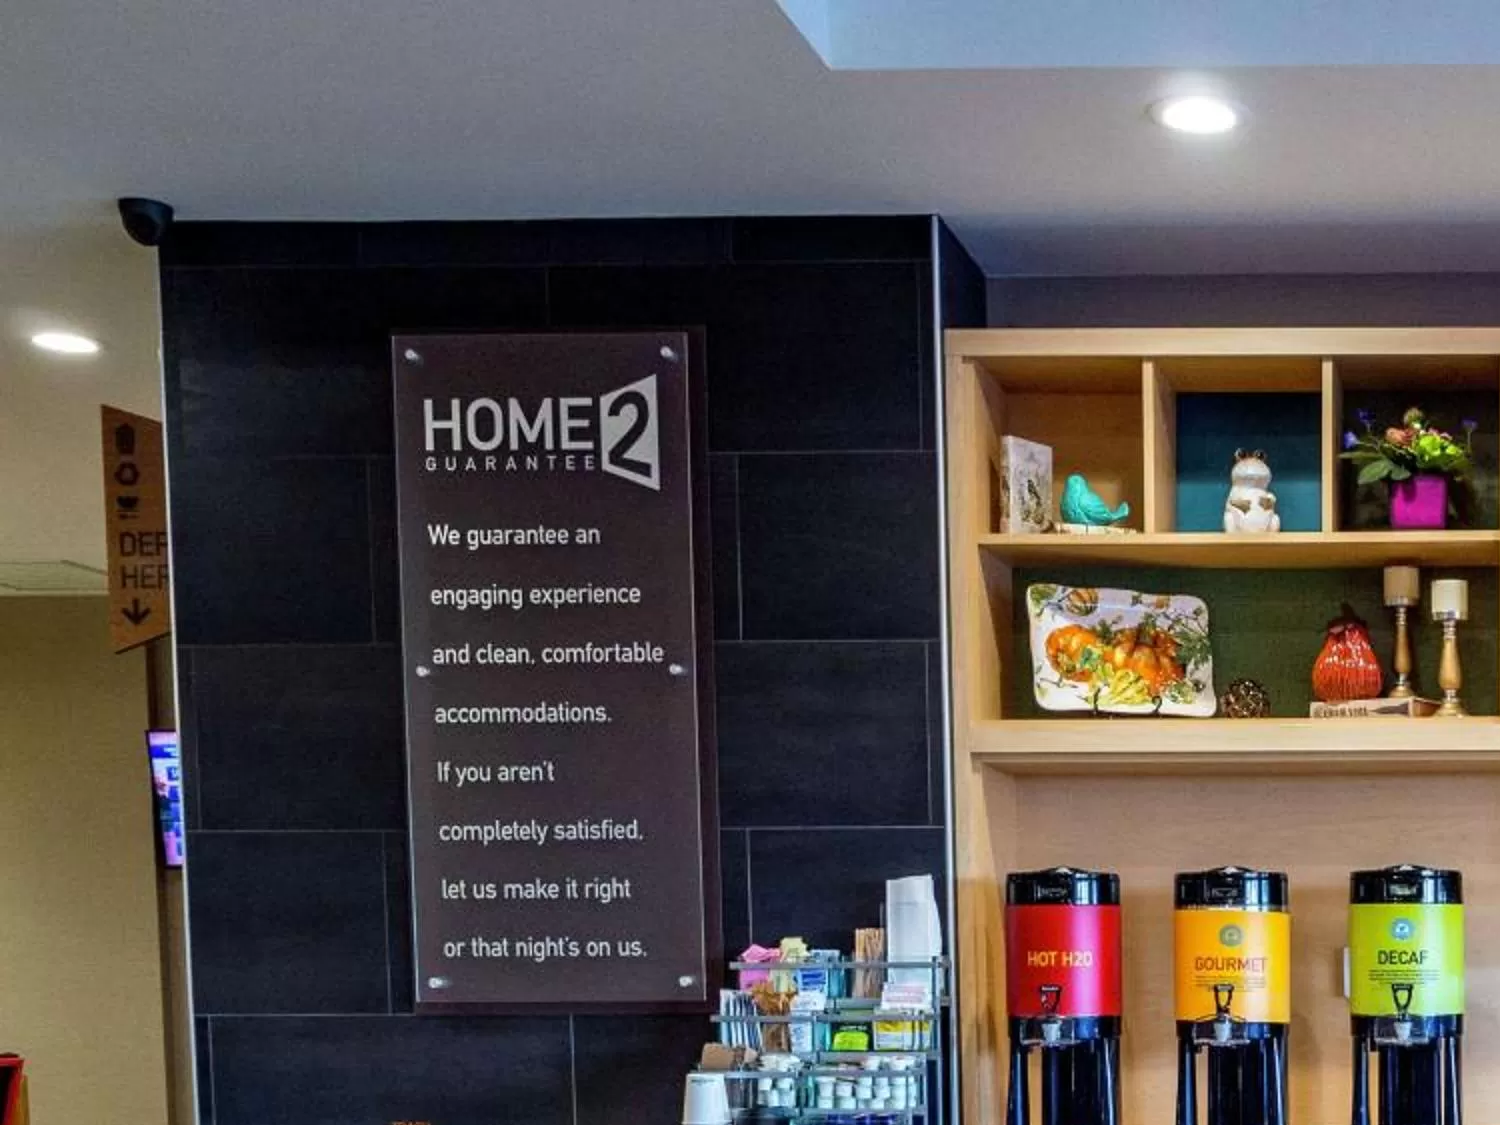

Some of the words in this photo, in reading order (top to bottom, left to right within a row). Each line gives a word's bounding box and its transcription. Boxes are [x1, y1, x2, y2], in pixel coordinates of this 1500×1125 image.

[423, 397, 595, 451] HOME
[425, 455, 596, 471] GUARANTEE
[427, 524, 461, 545] We
[467, 526, 569, 550] guarantee
[575, 528, 601, 545] an
[430, 584, 523, 610] engaging
[529, 583, 641, 608] experience
[432, 643, 470, 664] and
[541, 642, 664, 663] comfortable
[434, 701, 613, 723] accommodations.
[436, 761, 450, 782] If
[455, 765, 491, 787] you
[497, 760, 555, 782] aren't
[439, 820, 549, 846] completely
[441, 878, 467, 899] let
[472, 883, 497, 899] us
[503, 878, 560, 899] make
[565, 878, 579, 899] it
[584, 878, 631, 903] right
[443, 942, 465, 957] or
[471, 938, 509, 957] that
[515, 937, 580, 962] night's
[586, 941, 611, 957] on
[617, 940, 648, 957] us.
[1027, 951, 1058, 967] HOT
[1376, 949, 1429, 965] DECAF
[1194, 956, 1269, 972] GOURMET
